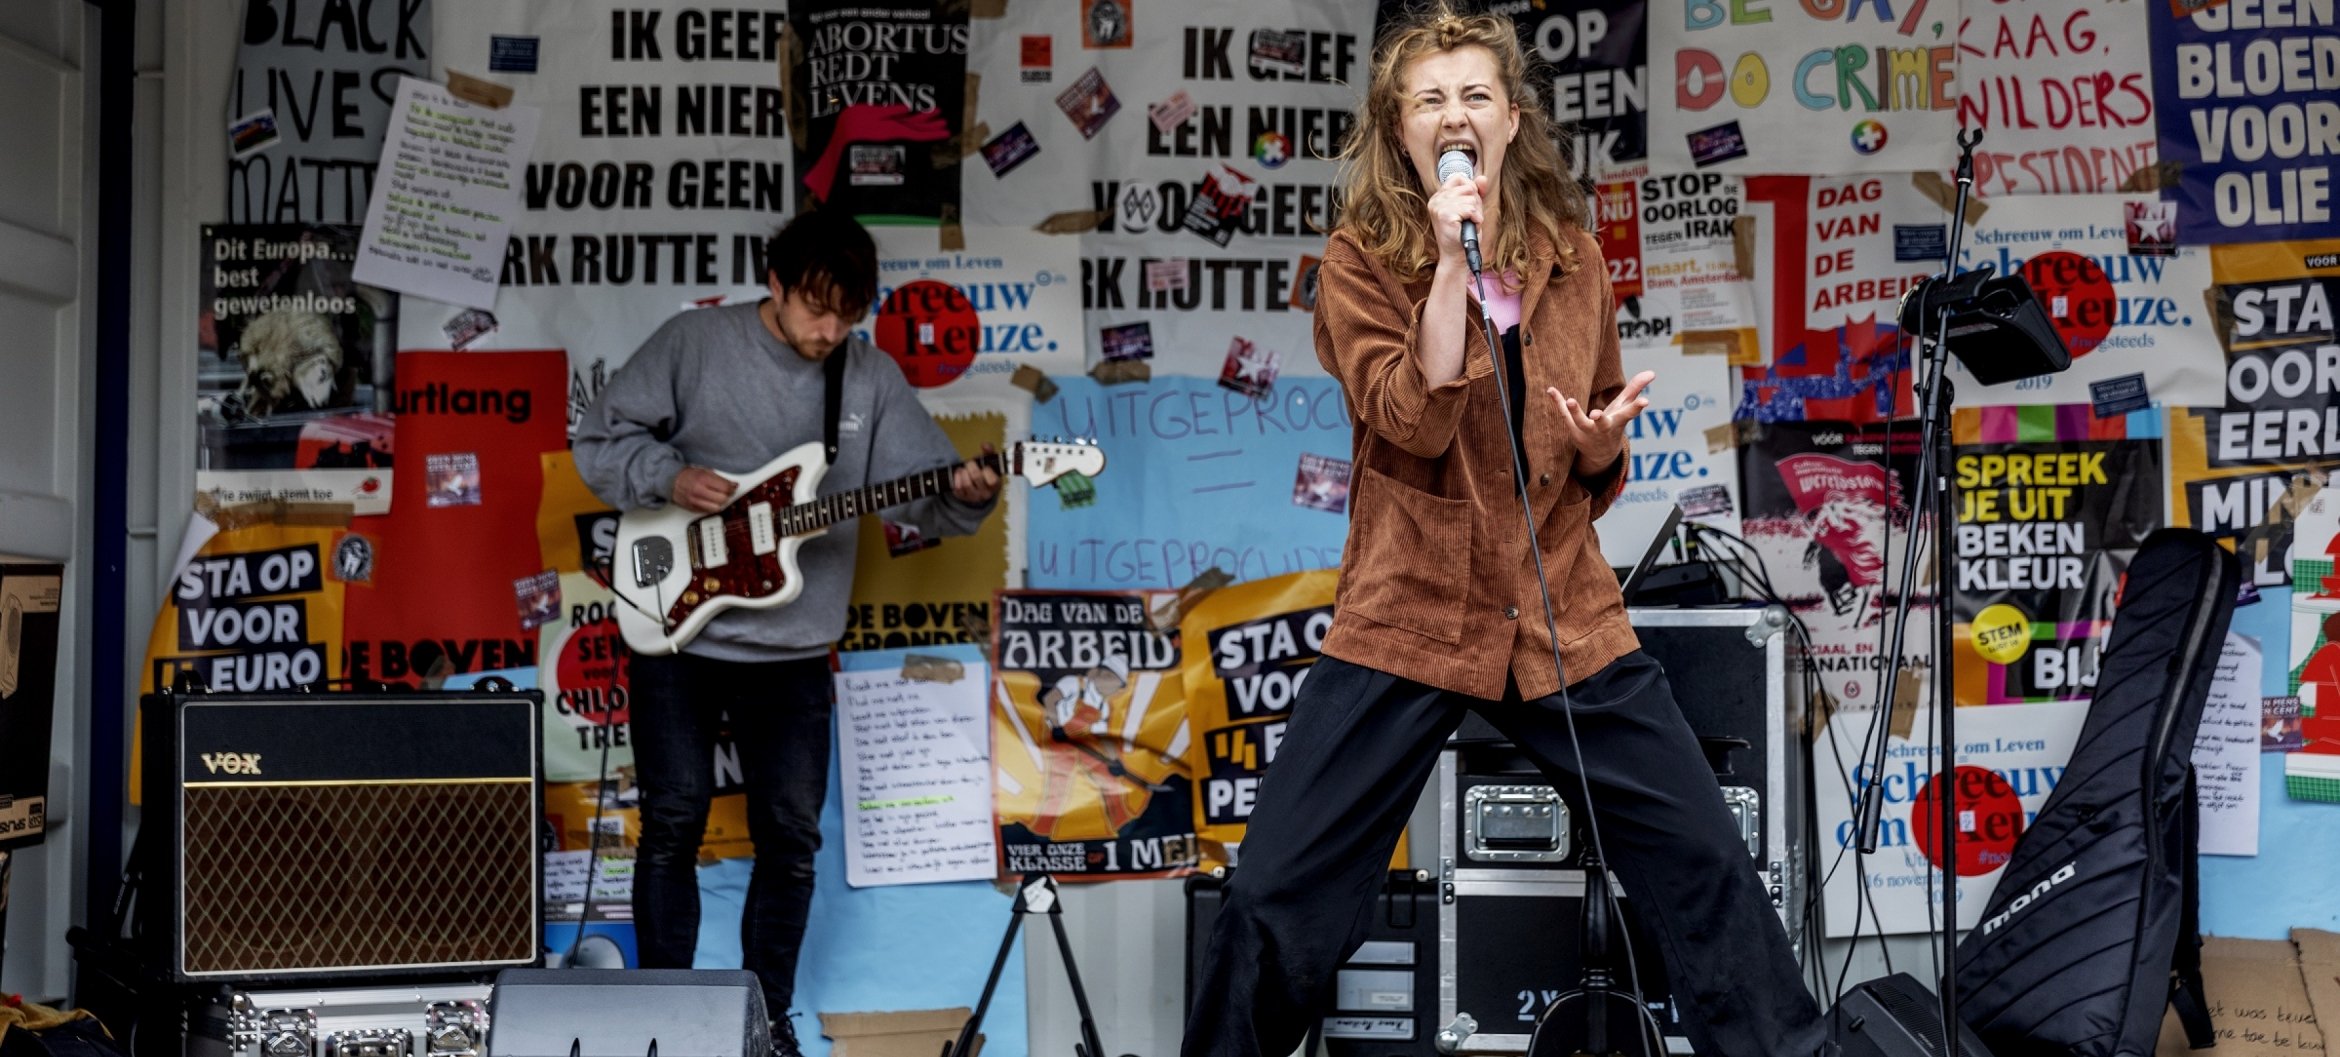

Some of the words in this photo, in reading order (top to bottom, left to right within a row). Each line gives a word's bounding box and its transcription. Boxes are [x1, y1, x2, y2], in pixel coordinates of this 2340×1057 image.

[244, 0, 426, 59] BLACK
[612, 10, 662, 61] IK
[675, 10, 784, 62] GEEF
[808, 21, 969, 58] ABORTUS
[1536, 10, 1608, 64] OP
[810, 52, 899, 87] REDT
[1184, 27, 1235, 79] IK
[1248, 28, 1357, 83] GEF
[2177, 36, 2340, 99] BLOED
[1554, 64, 1647, 123] EEN
[1675, 47, 1770, 111] DO
[1793, 44, 1958, 111] CRIME
[581, 86, 661, 137] EEN
[676, 86, 784, 138] NIER
[810, 81, 937, 118] LEVENS
[1957, 70, 2154, 130] WILDERS
[2190, 101, 2340, 163] VOOR
[526, 162, 653, 211] VOOR
[667, 160, 784, 213] GEEN
[1642, 174, 1721, 201] STOP
[1817, 179, 1882, 209] DAG
[2214, 166, 2330, 228] OLIE
[1644, 199, 1738, 223] OORLOG
[1817, 213, 1881, 243] VAN
[214, 239, 255, 261] Dit
[1646, 231, 1682, 246] TEGEN
[1685, 219, 1736, 240] IRAK
[1975, 229, 2052, 246] Schreeuw
[2058, 228, 2084, 241] om
[2090, 225, 2125, 240] Leve
[214, 266, 259, 288] best
[572, 234, 718, 285] RUTTE
[926, 258, 950, 270] om
[956, 255, 1002, 269] Leven
[1609, 257, 1639, 282] 22
[1815, 249, 1854, 278] DE
[2306, 255, 2338, 268] VOOR
[214, 291, 357, 317] gewetenloos
[2233, 283, 2333, 336] STA
[1956, 451, 2107, 489] SPREEK
[313, 488, 333, 500] toe
[1959, 489, 2003, 523] JE
[2008, 487, 2071, 521] UIT
[1957, 522, 2084, 558] BEKEN
[179, 558, 250, 600] STA
[261, 551, 314, 591] OP
[1958, 557, 2084, 592] KLEUR
[188, 604, 300, 647] VOOR
[882, 602, 989, 629] BOVEN
[1004, 597, 1055, 624] DAG
[1061, 603, 1112, 624] VAN
[1115, 602, 1143, 625] DE
[1004, 630, 1174, 668] ARBEID
[1219, 617, 1298, 669] STA
[1977, 622, 2022, 648] STEM
[211, 648, 322, 692] EURO
[381, 639, 534, 678] BOVEN
[203, 752, 262, 775] VOX
[1965, 741, 1990, 754] om
[1996, 737, 2045, 753] Leven
[1007, 843, 1042, 857] VIER
[1047, 842, 1086, 857] ONZE
[1009, 856, 1086, 871] KLASSE
[1103, 842, 1120, 871] 1
[1984, 860, 2077, 936] mono
[1517, 989, 1536, 1021] 2
